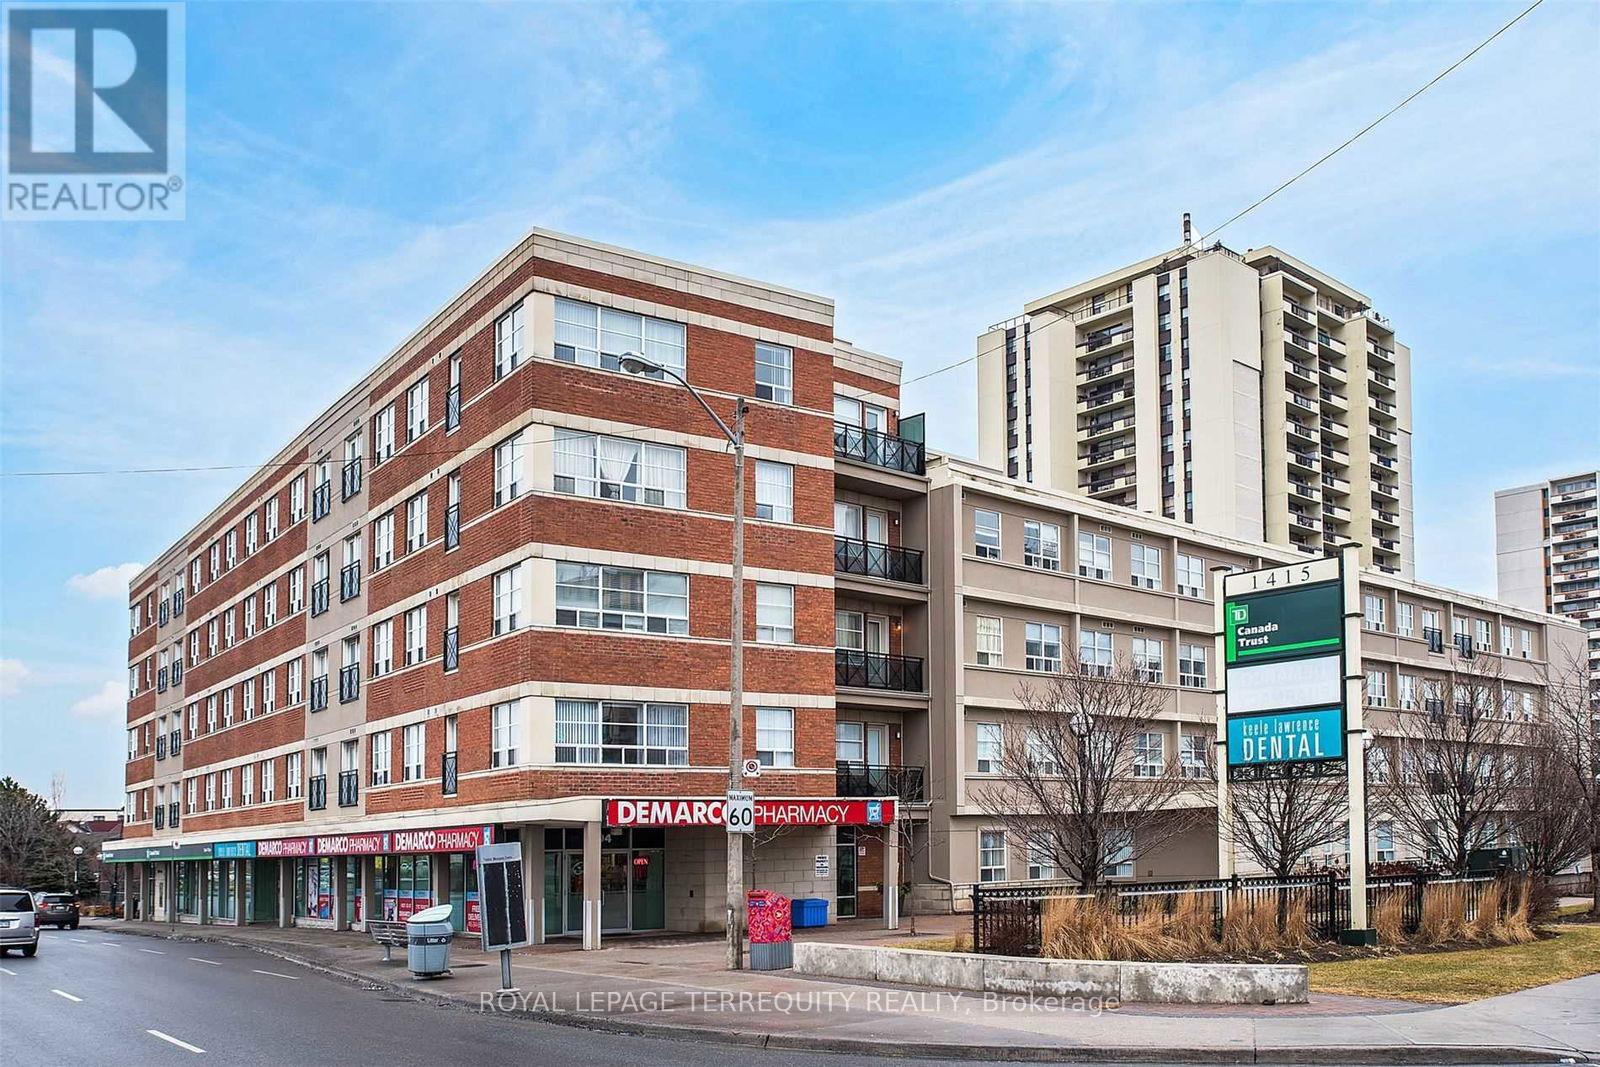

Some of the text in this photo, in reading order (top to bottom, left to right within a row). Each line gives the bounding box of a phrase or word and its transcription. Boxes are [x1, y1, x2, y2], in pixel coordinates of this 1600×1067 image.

[1253, 566, 1310, 589] 1415
[1232, 609, 1247, 621] TD
[1237, 622, 1279, 636] Canada
[1237, 635, 1269, 647] Trust
[1243, 718, 1320, 736] keele lawrence
[1243, 733, 1324, 761] DENTAL
[729, 808, 752, 826] 60
[754, 805, 849, 823] PHARMACY
[257, 840, 307, 856] DEMARCO PHARMACY
[316, 836, 381, 854] DEMARCO PHARMACY
[395, 831, 480, 851] DEMARCO PHARMACY
